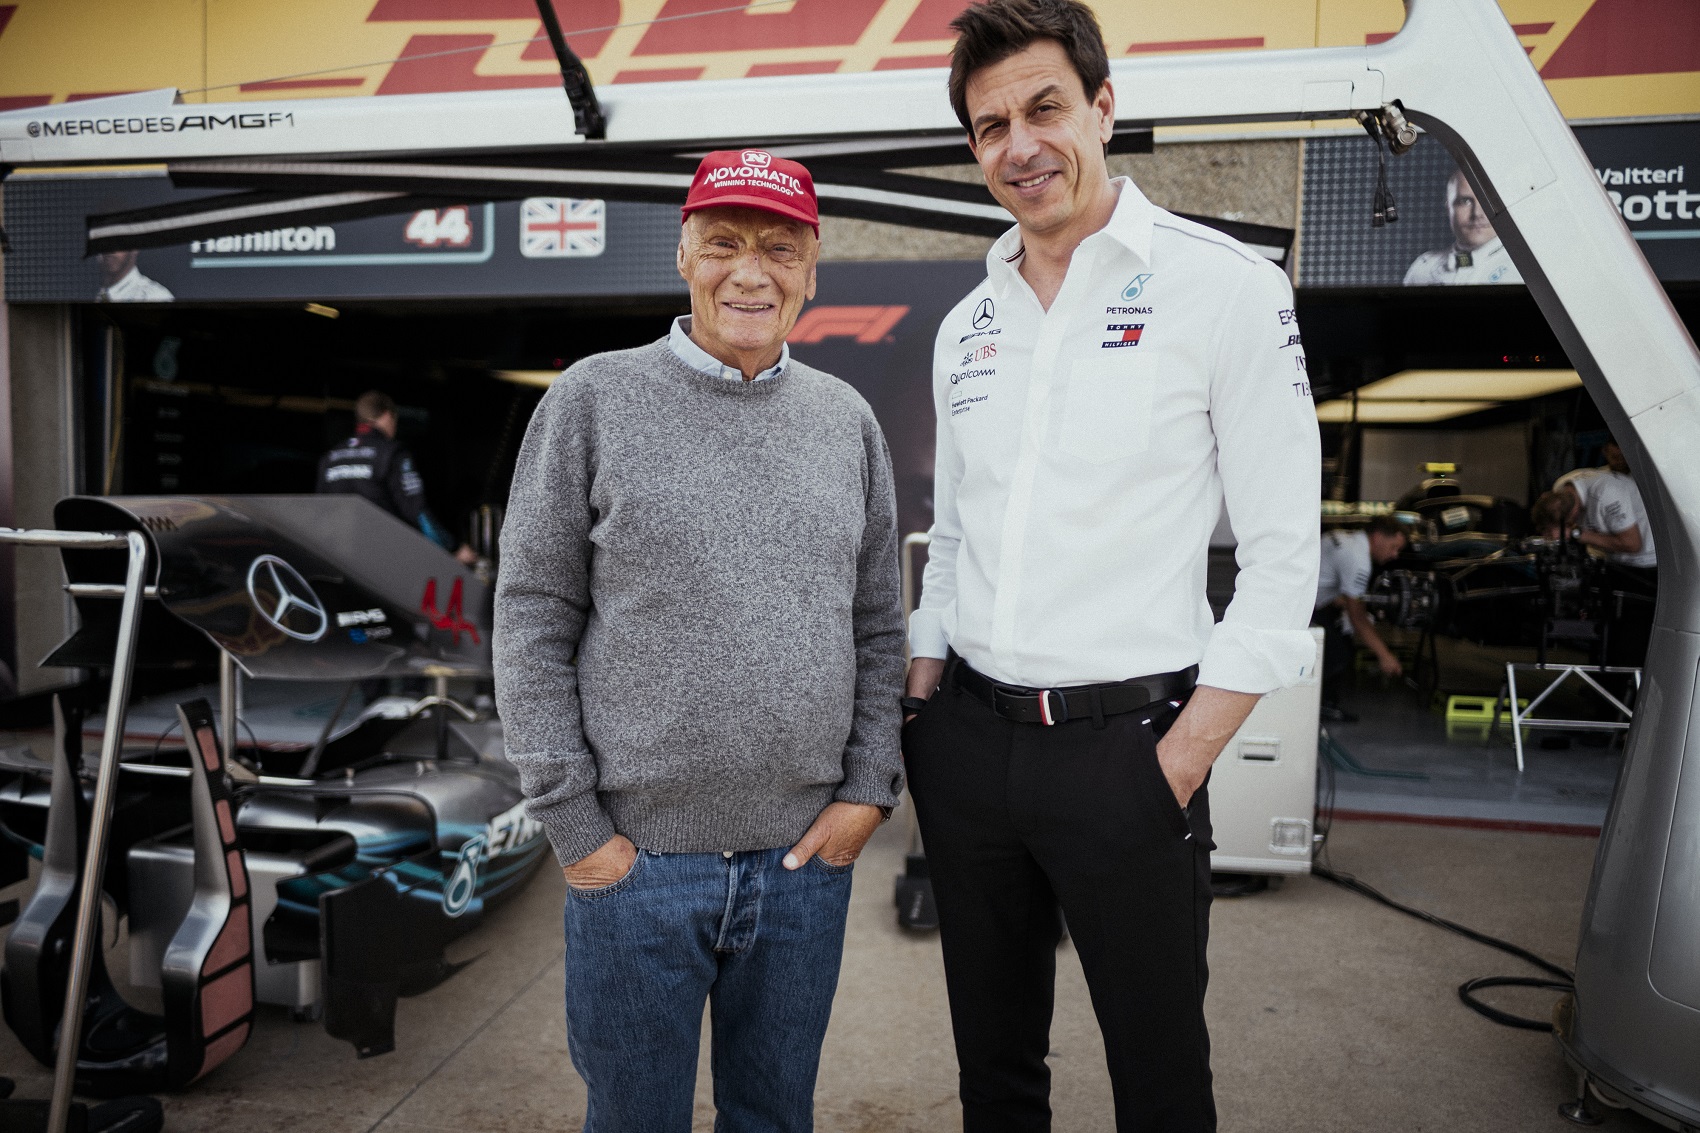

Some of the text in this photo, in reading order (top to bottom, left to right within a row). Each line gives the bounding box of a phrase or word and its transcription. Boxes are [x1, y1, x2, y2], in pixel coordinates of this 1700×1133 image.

[703, 167, 804, 195] NOVOMATIC
[714, 179, 795, 197] WINNING TECHNOLOGY
[402, 205, 473, 247] 44
[1106, 306, 1153, 315] PETRONAS
[974, 342, 998, 362] UBS
[950, 368, 996, 385] Qualcomm
[966, 394, 989, 405] Packard
